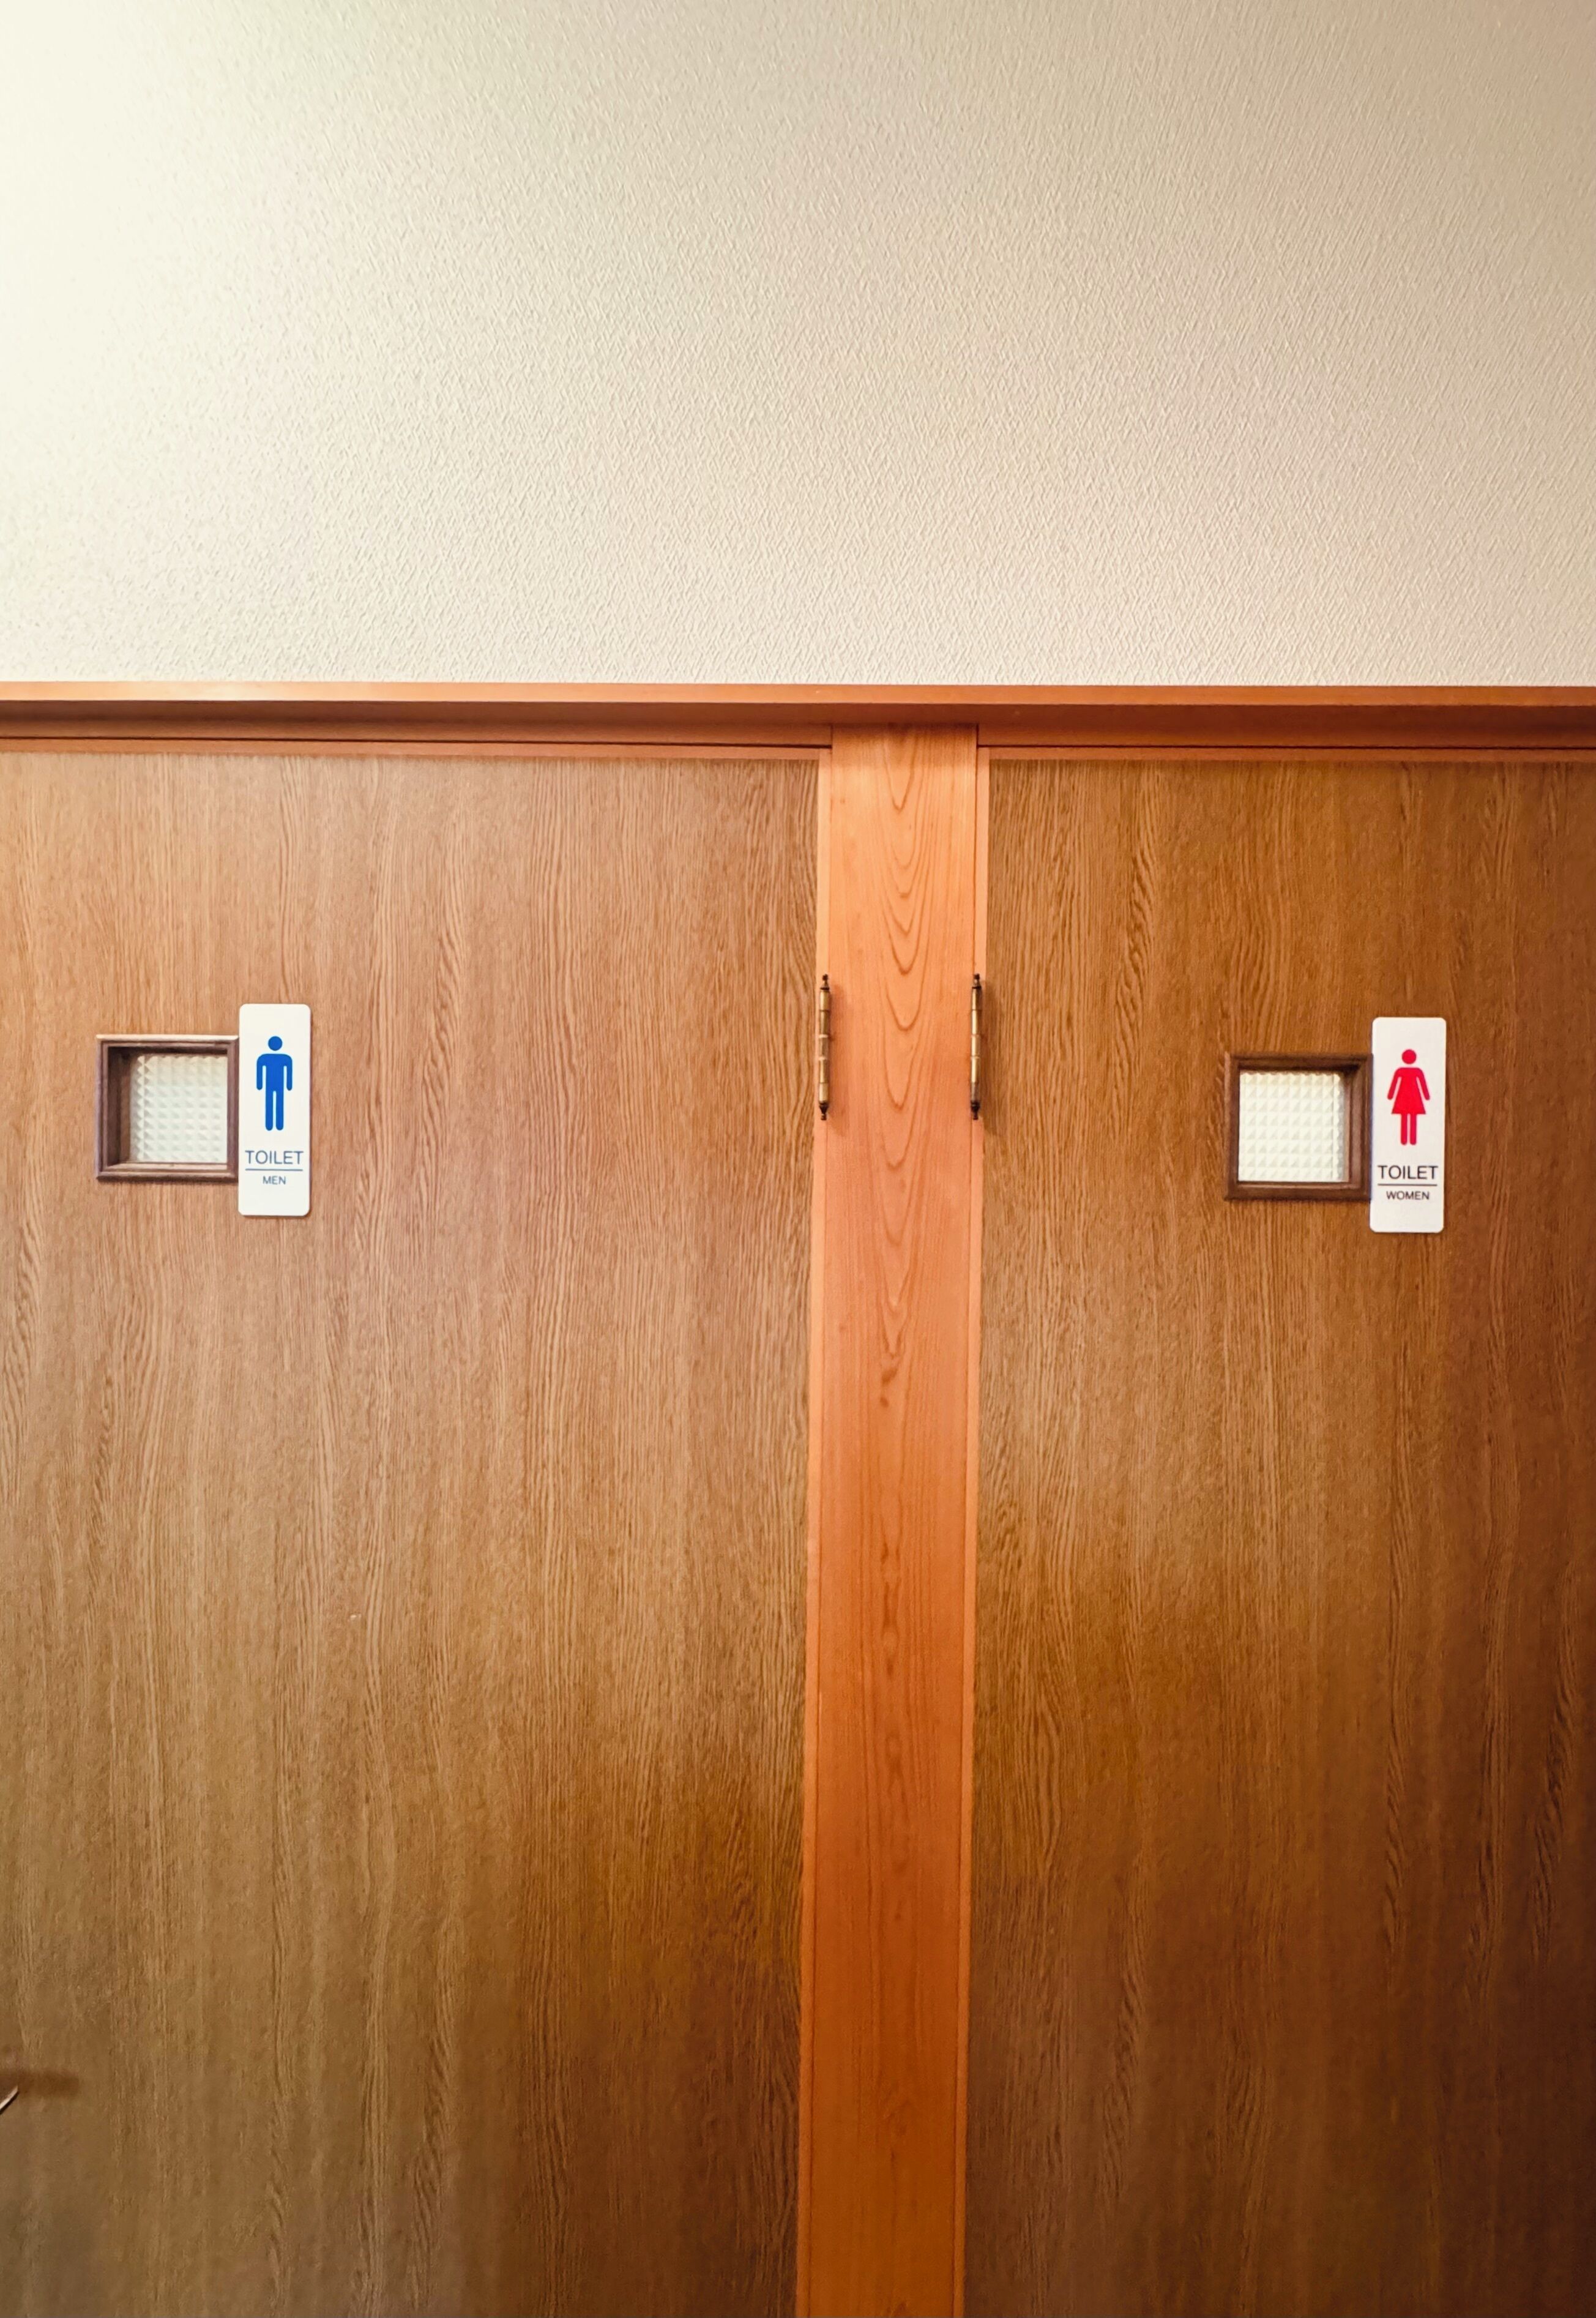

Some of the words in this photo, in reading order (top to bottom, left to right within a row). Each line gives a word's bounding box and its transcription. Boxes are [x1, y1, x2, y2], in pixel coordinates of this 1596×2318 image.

[245, 1150, 304, 1164] TOILET
[1378, 1165, 1439, 1180] TOILET
[263, 1175, 286, 1185] MEN
[1386, 1191, 1430, 1200] WOMEN
